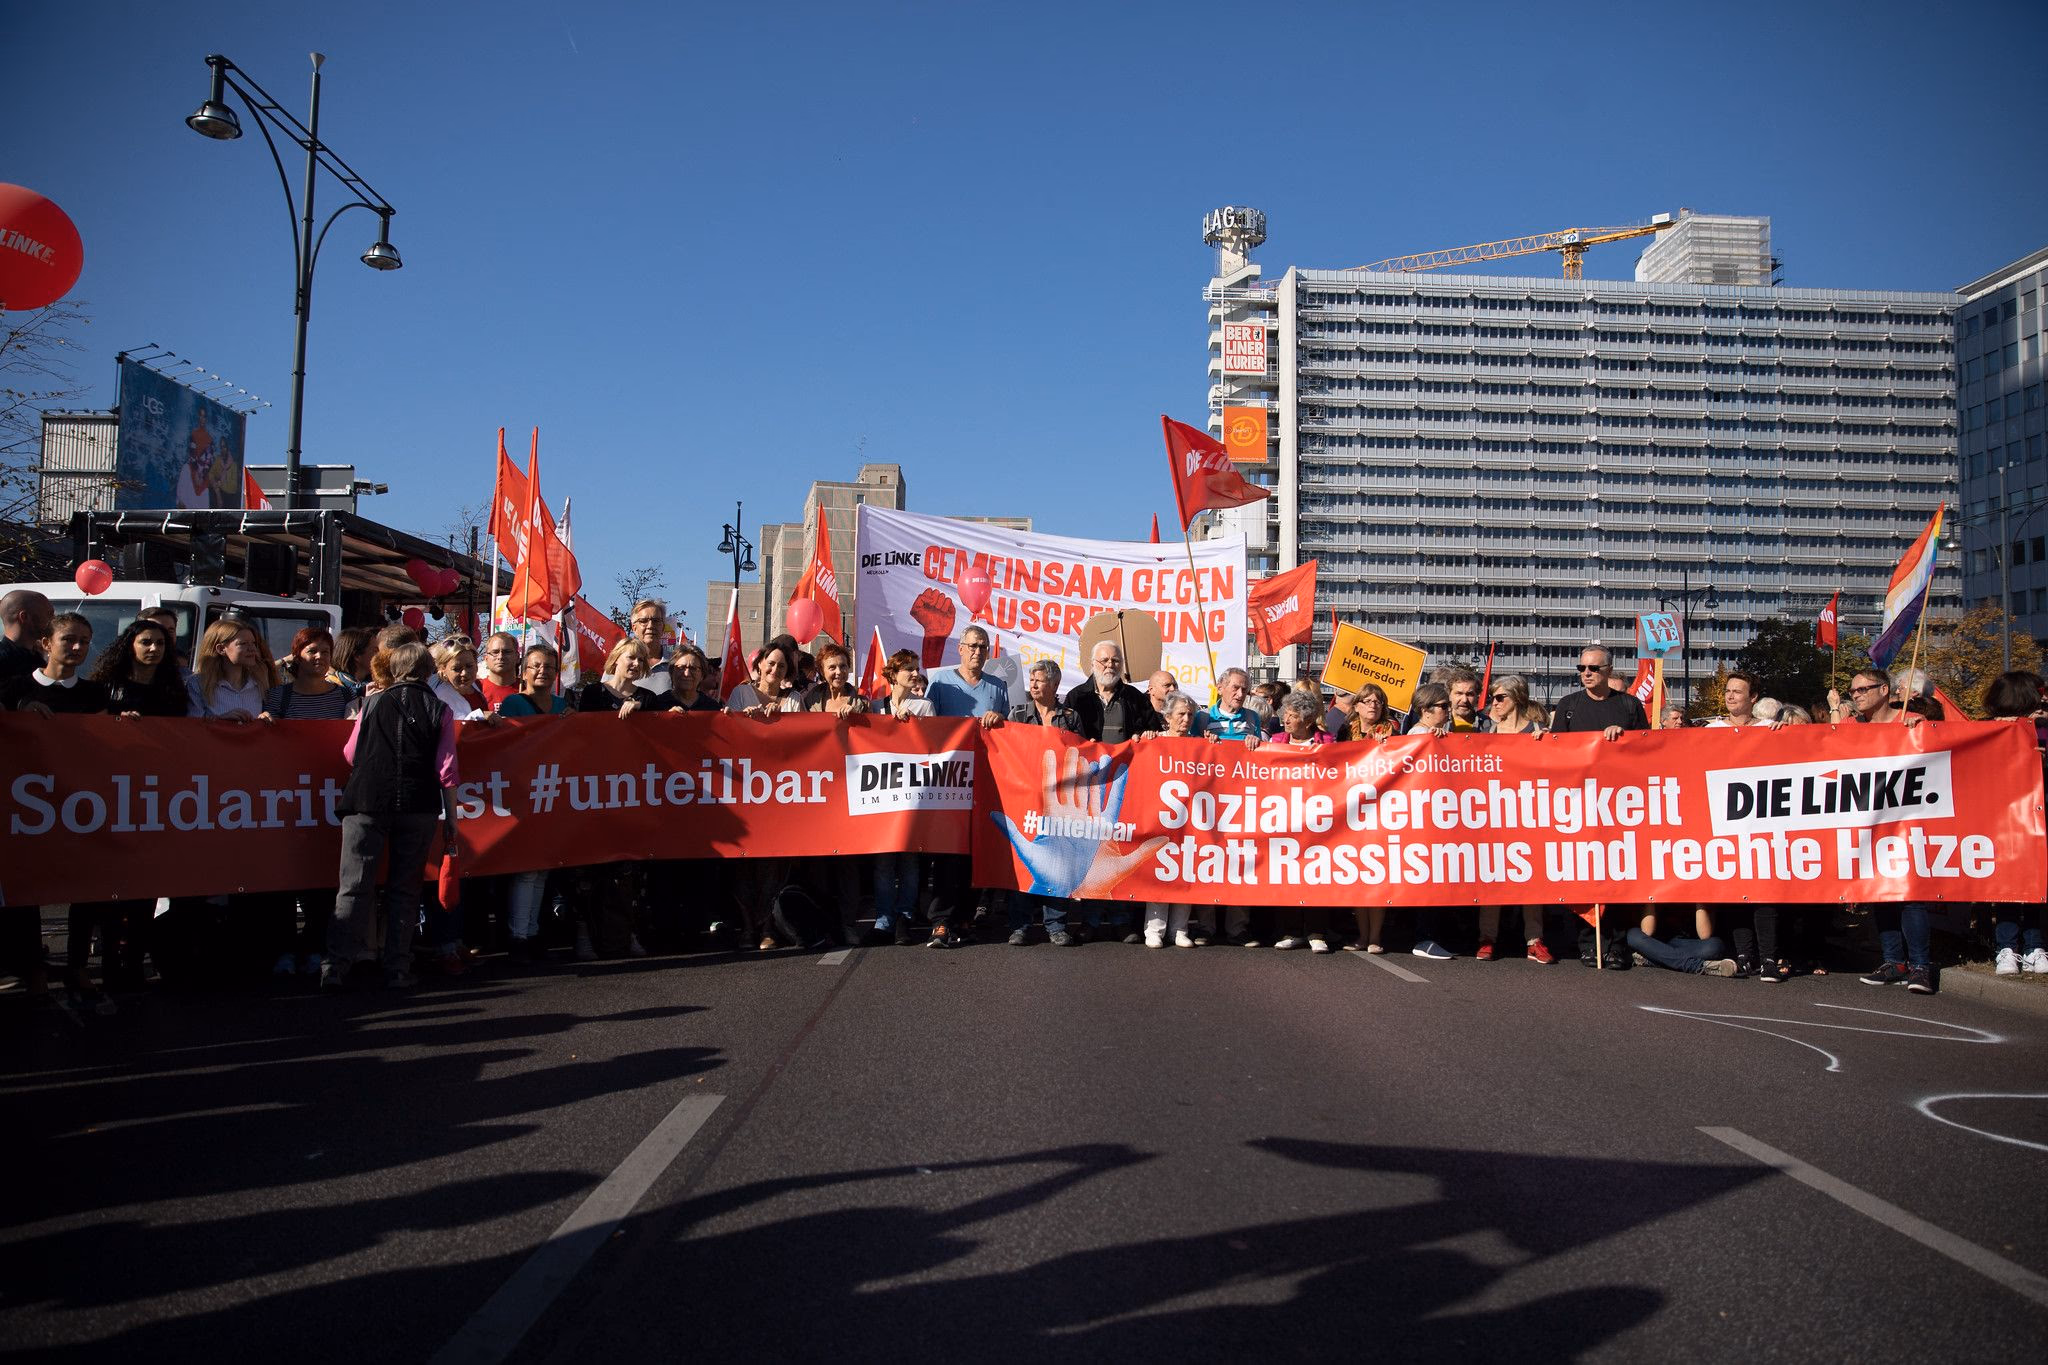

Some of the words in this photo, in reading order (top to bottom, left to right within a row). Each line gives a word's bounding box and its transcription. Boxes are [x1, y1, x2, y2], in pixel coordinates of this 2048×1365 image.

[1226, 326, 1252, 341] BER
[1226, 341, 1264, 356] LINER
[1226, 355, 1265, 370] KURIER
[862, 553, 882, 569] DIE
[1131, 565, 1234, 605] GEGEN
[1341, 657, 1406, 688] Hellersdorf
[1352, 645, 1405, 672] Marzahn-
[860, 762, 904, 792] DIE
[1159, 755, 1226, 778] Unsere
[1231, 760, 1338, 780] Alternative
[1345, 758, 1396, 779] heißt
[1401, 754, 1503, 775] Solidarität
[10, 773, 343, 835] Solidarit
[438, 771, 511, 821] st
[529, 757, 834, 814] #unteilbar
[861, 796, 880, 805] IM
[892, 792, 972, 802] BUNDESTAG
[1158, 780, 1334, 834] Soziale
[1346, 776, 1682, 834] Gerechtigkeit
[1726, 778, 1793, 821] DIE
[1023, 810, 1137, 842] #unteilbar
[1154, 835, 1258, 885] statt
[1268, 835, 1533, 885] Rassismus
[1545, 831, 1638, 882] und
[1651, 829, 1822, 881] rechte
[1836, 827, 1996, 880] Hetze
